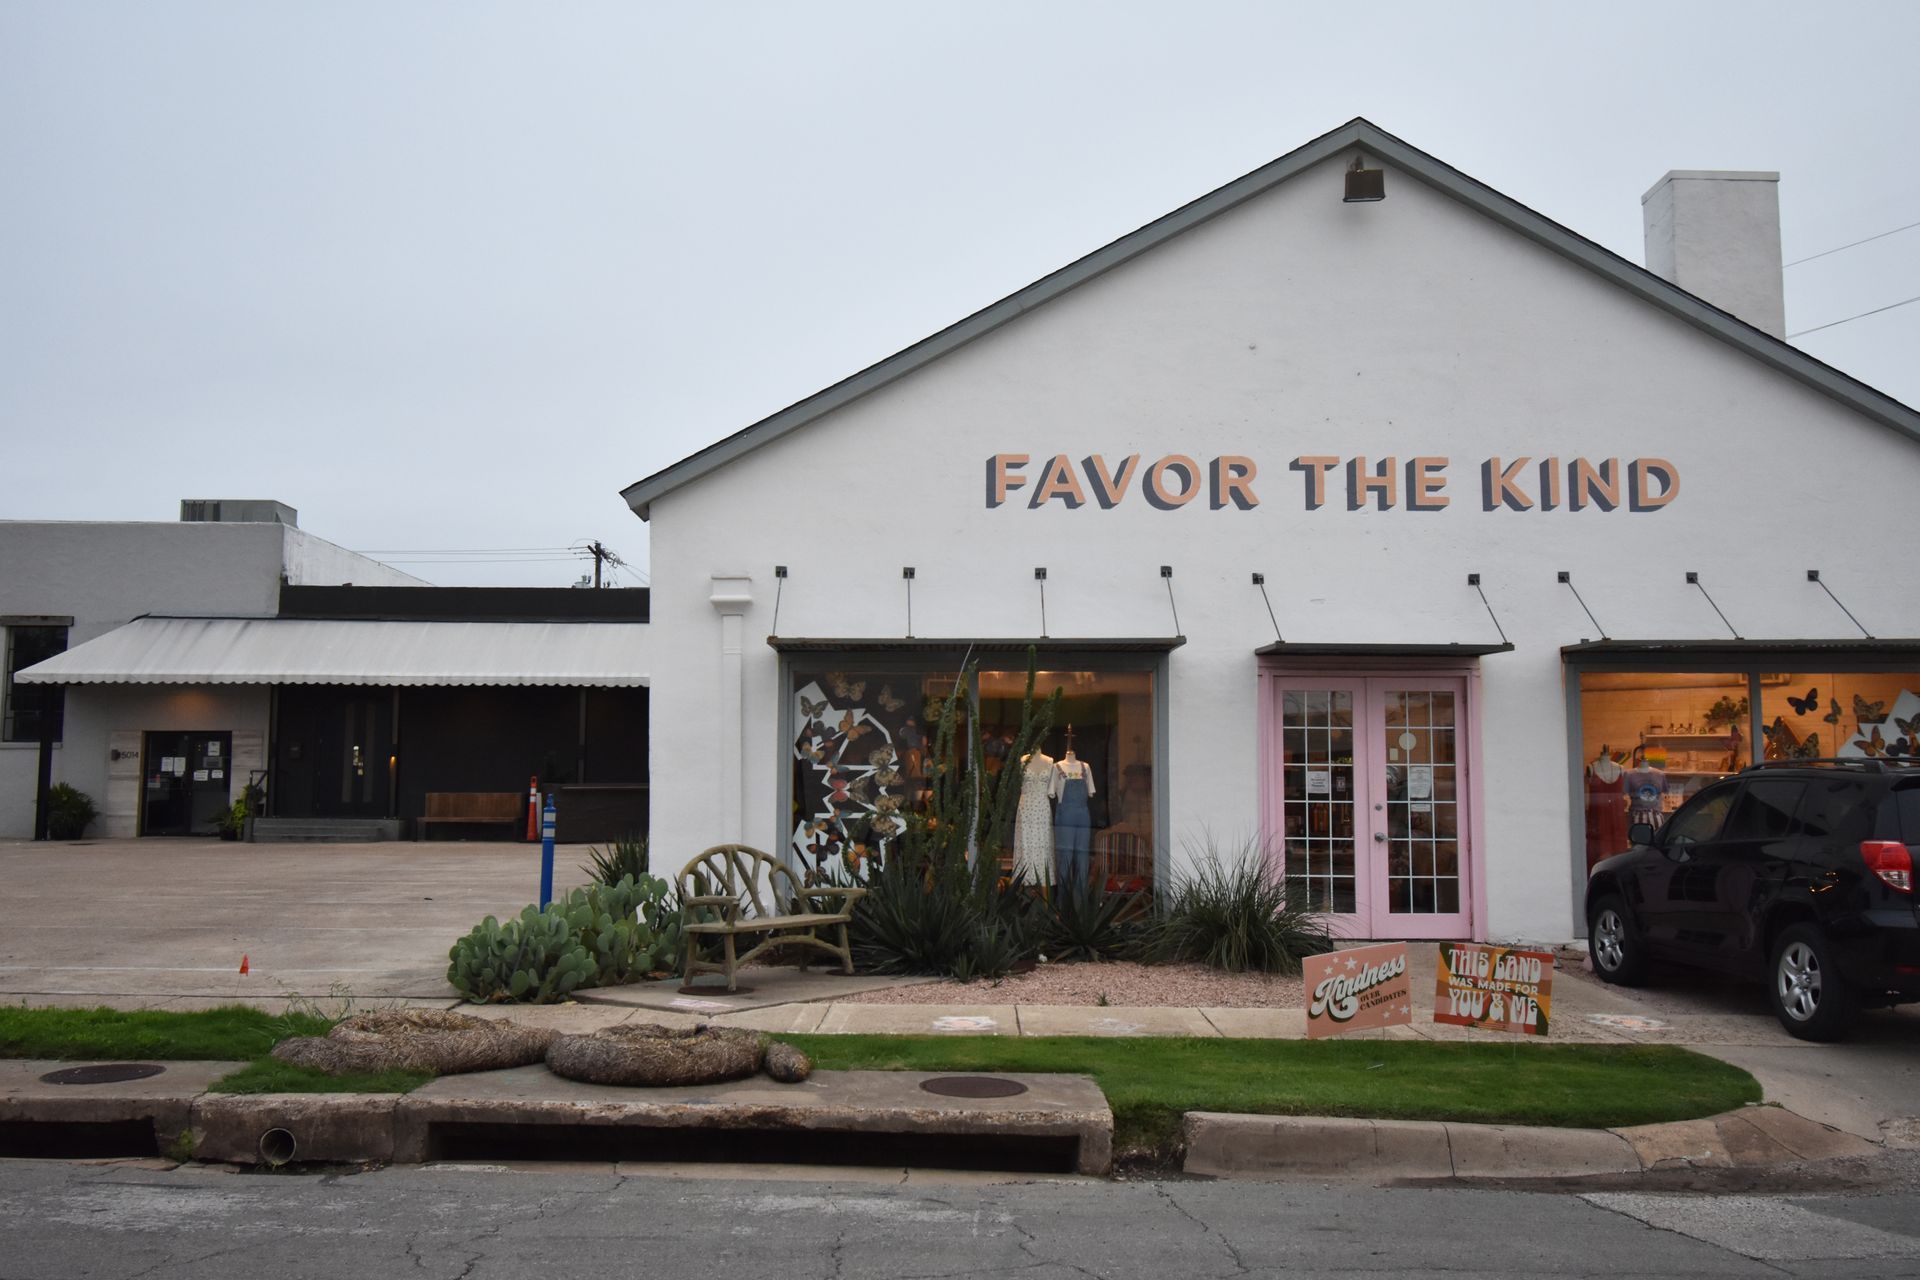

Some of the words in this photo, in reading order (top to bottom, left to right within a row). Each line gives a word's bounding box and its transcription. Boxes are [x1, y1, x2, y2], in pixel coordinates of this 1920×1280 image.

[986, 454, 1259, 510] FAVOR
[1289, 456, 1450, 511] THE
[1481, 457, 1680, 512] KIND
[1448, 949, 1489, 978] THIS
[1494, 953, 1542, 984] LAND
[1309, 954, 1406, 1023] Kindness
[1360, 990, 1380, 1003] OVER
[1360, 990, 1407, 1011] CANDIDATES
[1448, 976, 1474, 987] WAS
[1478, 981, 1512, 993] MADE
[1515, 984, 1538, 995] FOR
[1448, 988, 1485, 1019] YOU
[1489, 992, 1504, 1022] &
[1510, 995, 1538, 1026] ME
